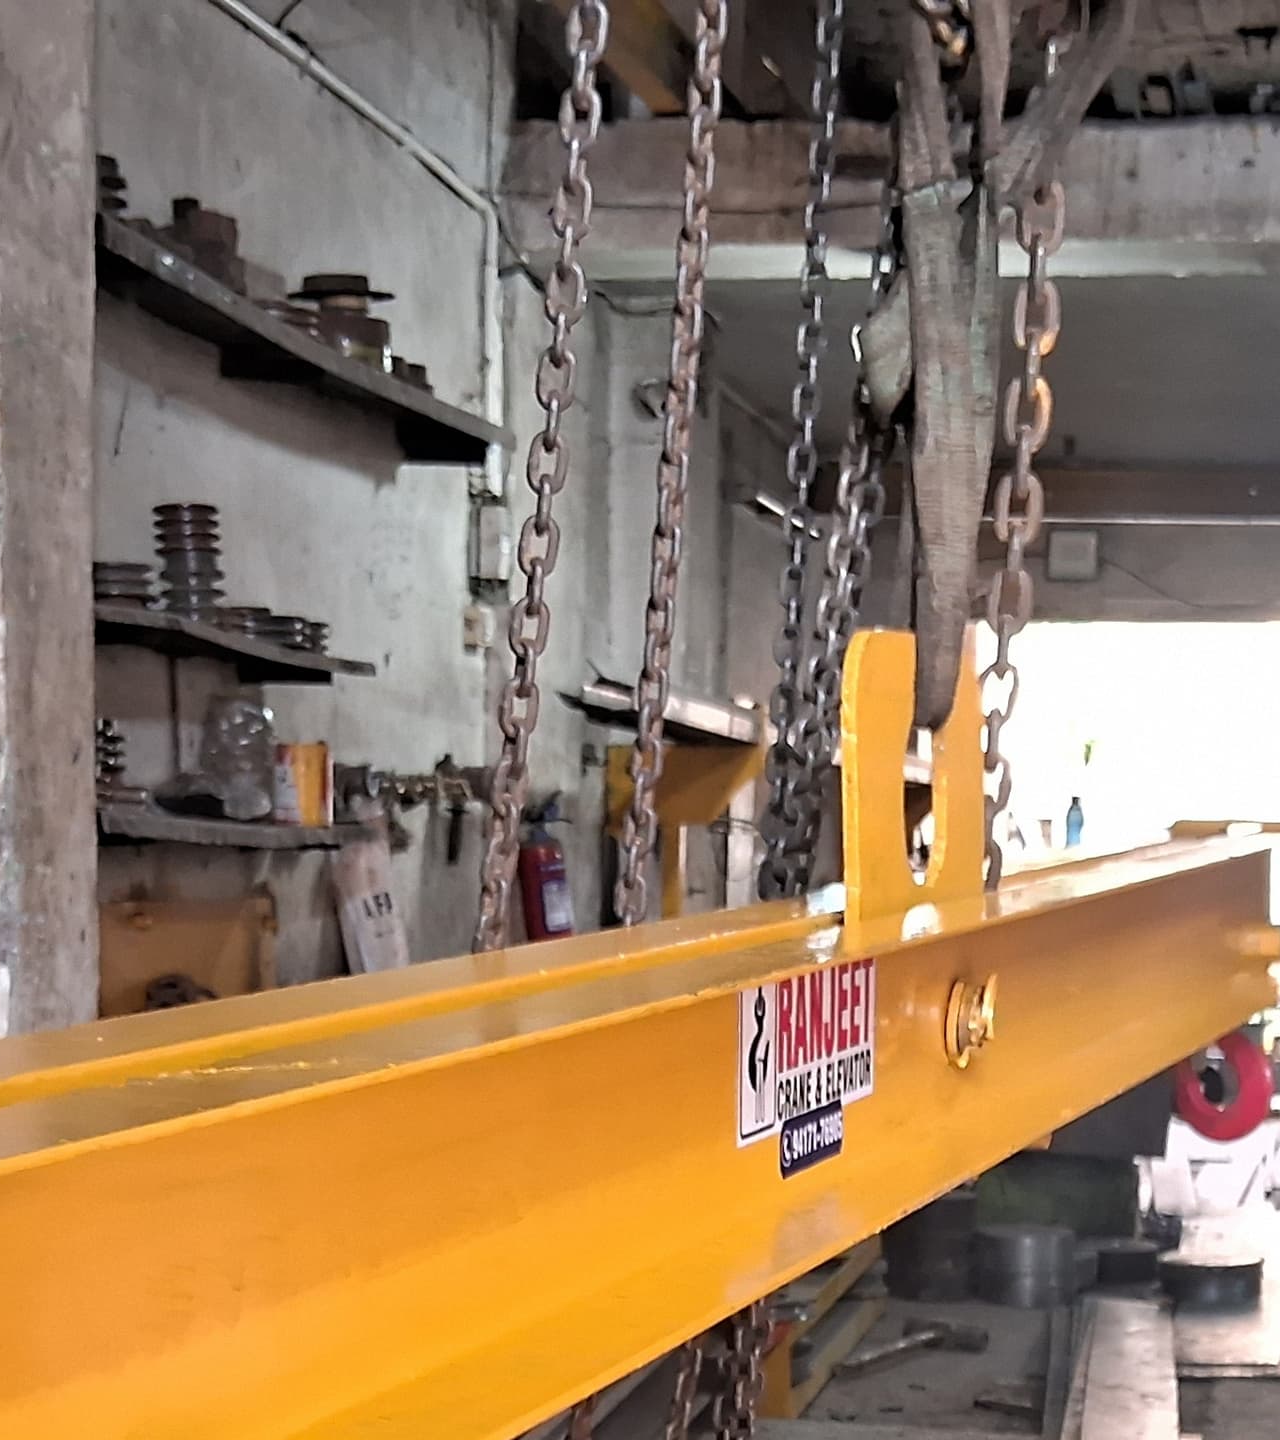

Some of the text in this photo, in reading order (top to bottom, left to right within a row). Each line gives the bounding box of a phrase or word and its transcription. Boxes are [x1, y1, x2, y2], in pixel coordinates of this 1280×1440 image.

[778, 957, 874, 1074] RANJEET
[777, 1049, 871, 1121] CRANE & ELEVATOR
